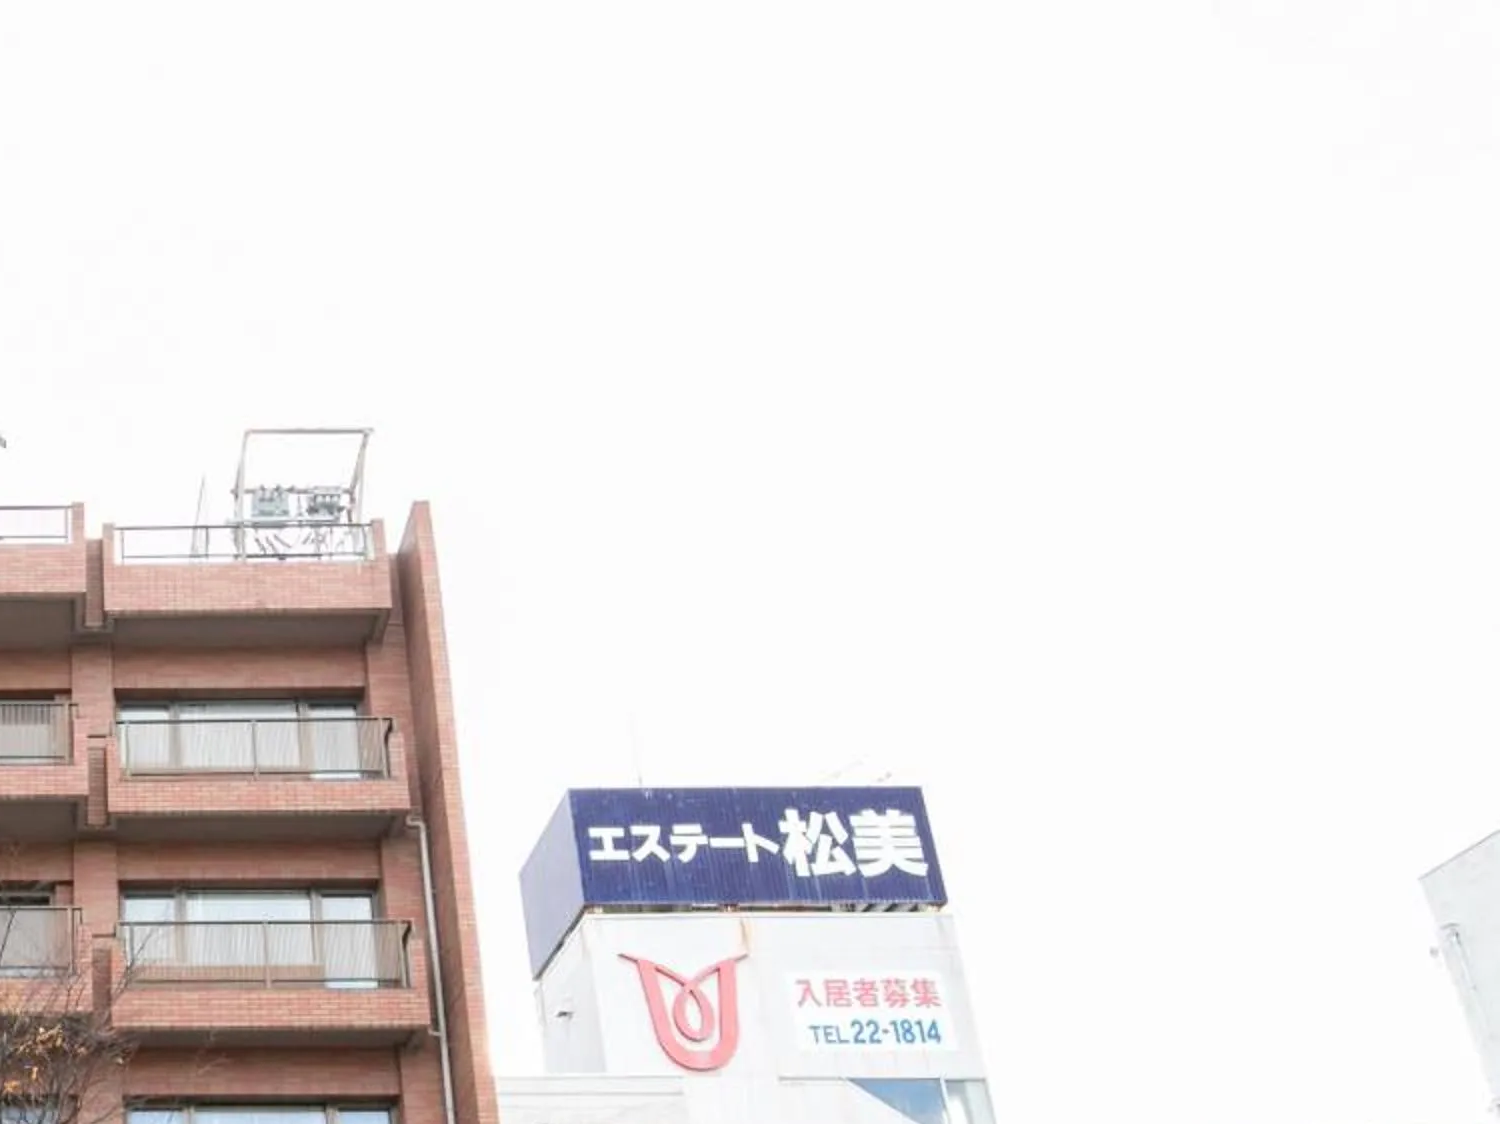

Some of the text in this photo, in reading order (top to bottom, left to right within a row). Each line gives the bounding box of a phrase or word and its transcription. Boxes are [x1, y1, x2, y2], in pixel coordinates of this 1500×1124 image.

[588, 808, 929, 877] エステート松美
[795, 978, 942, 1008] 入居者募集
[808, 1018, 942, 1044] TEL 22-1814
